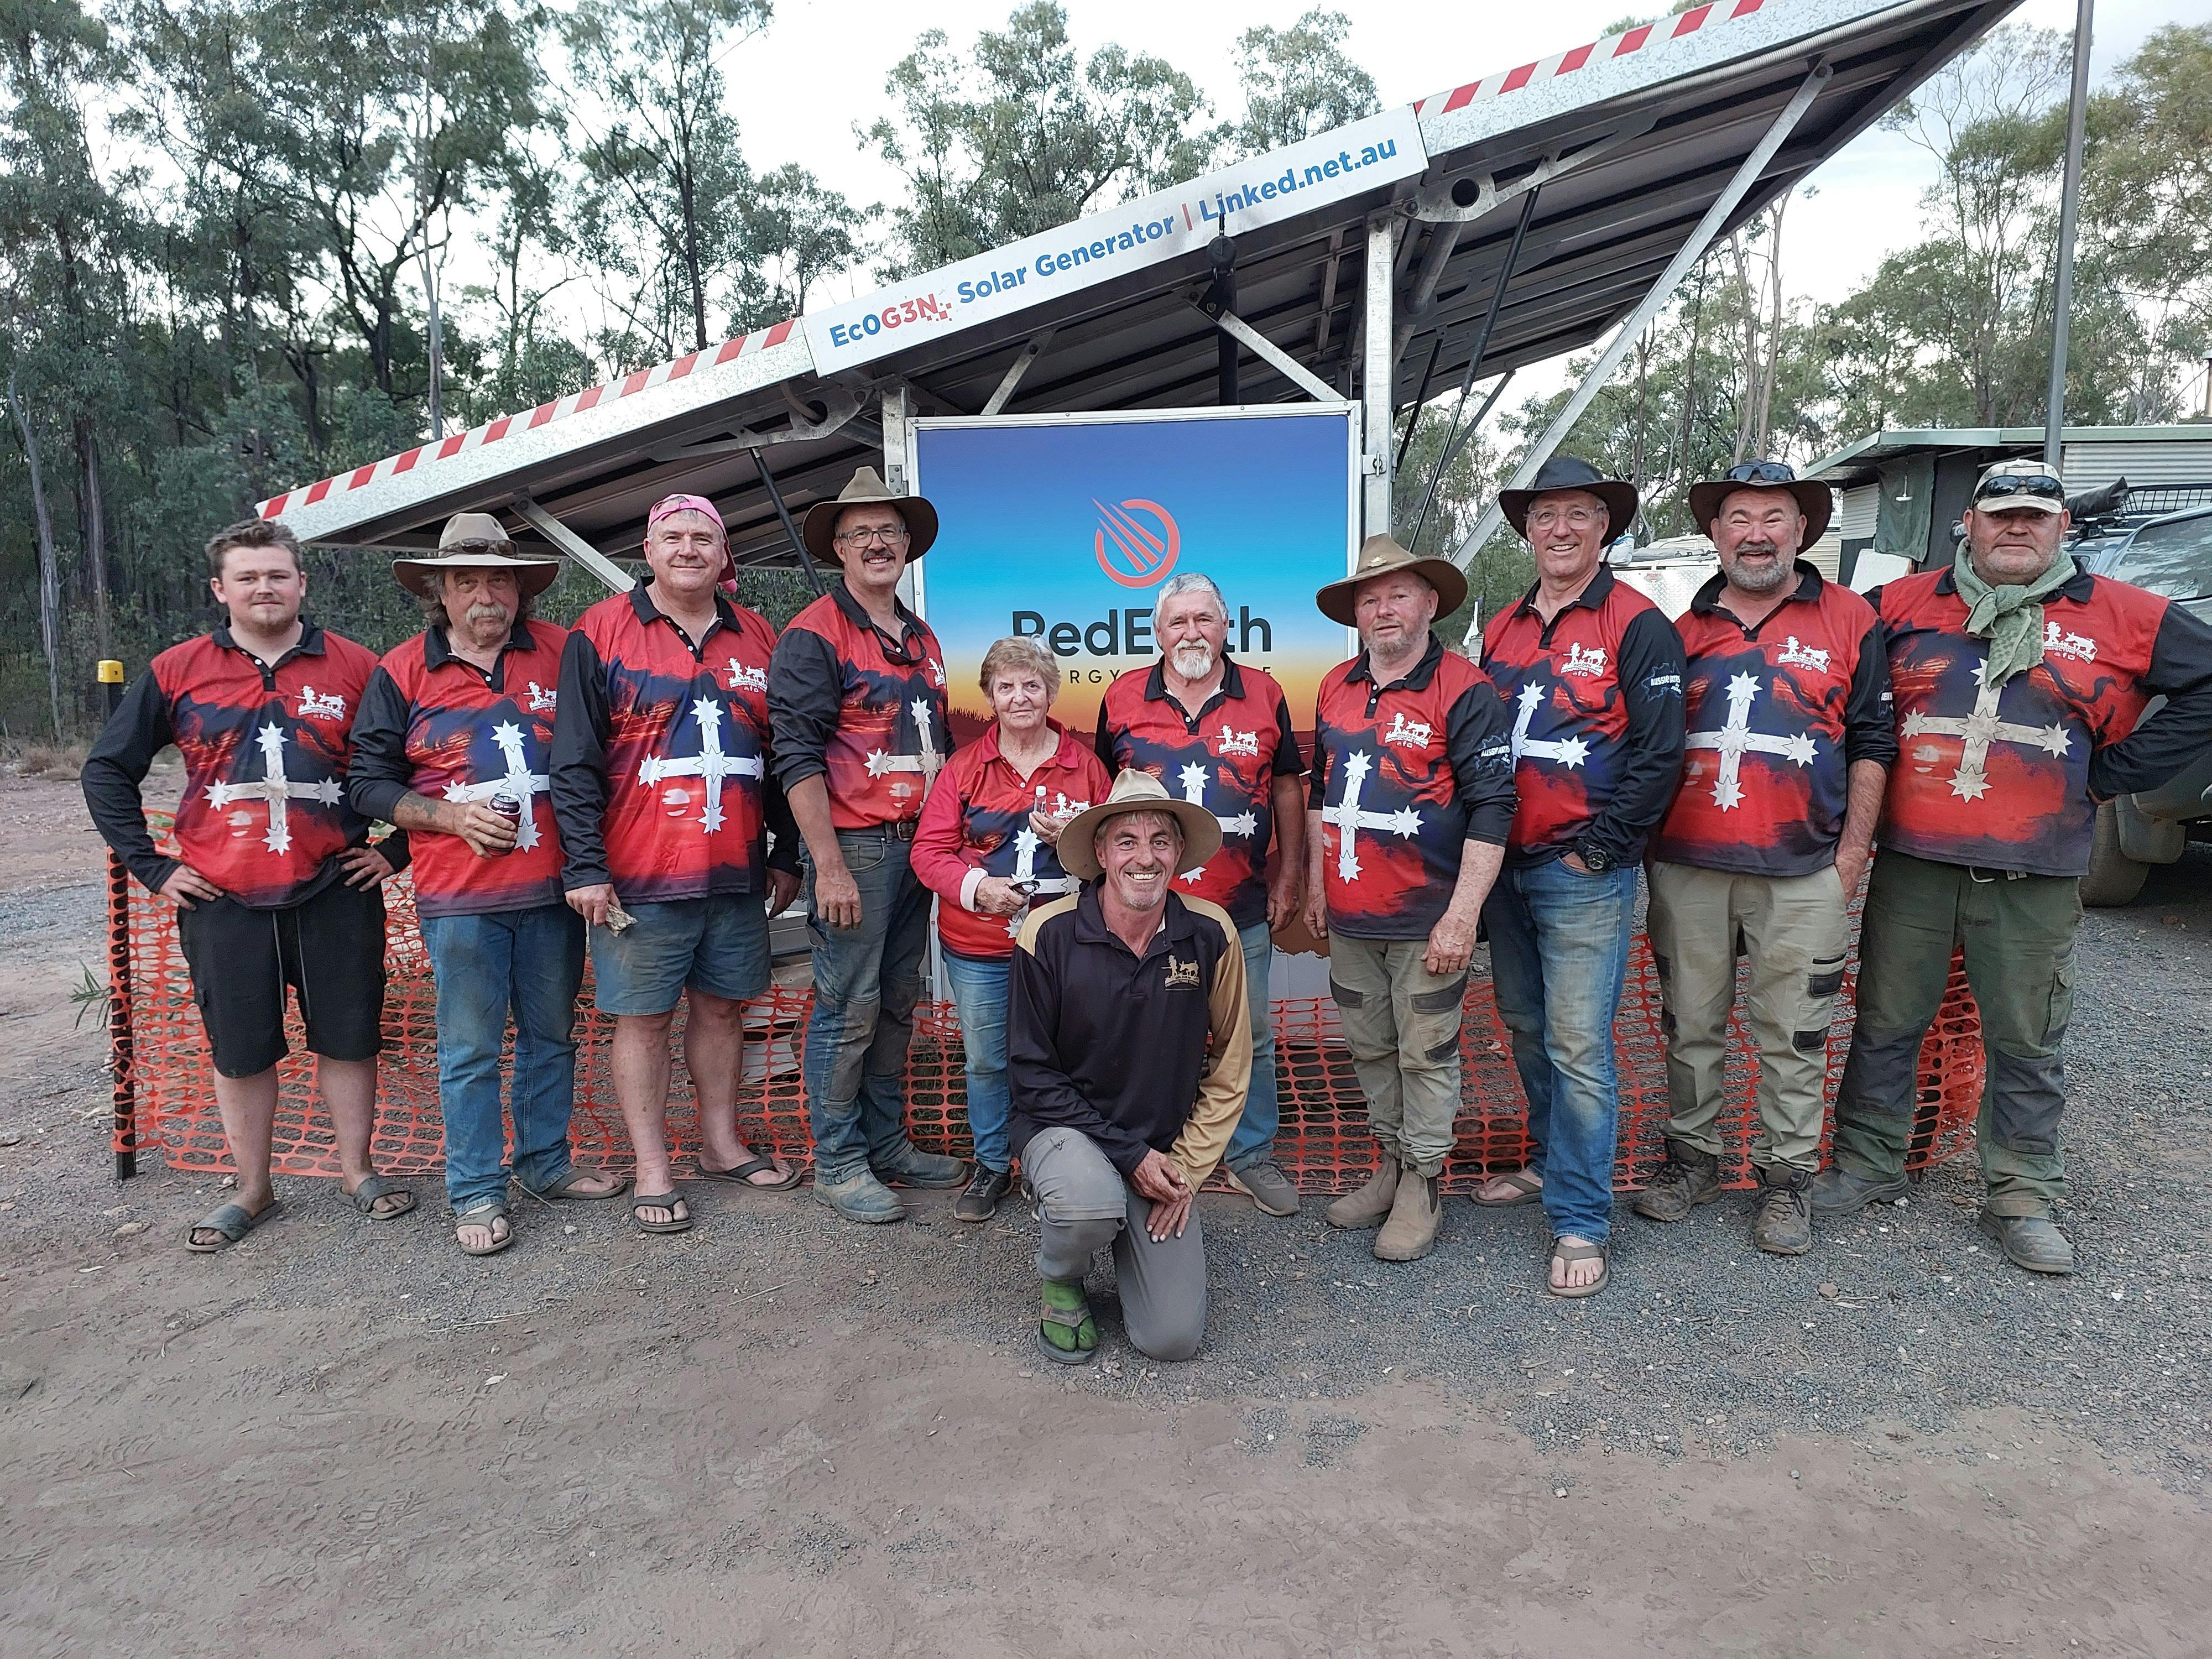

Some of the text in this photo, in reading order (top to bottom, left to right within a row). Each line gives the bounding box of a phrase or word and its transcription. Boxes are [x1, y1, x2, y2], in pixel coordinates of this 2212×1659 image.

[958, 267, 1027, 304] Solar
[1035, 213, 1175, 277] Generator
[1199, 139, 1397, 222] Linked.net.au
